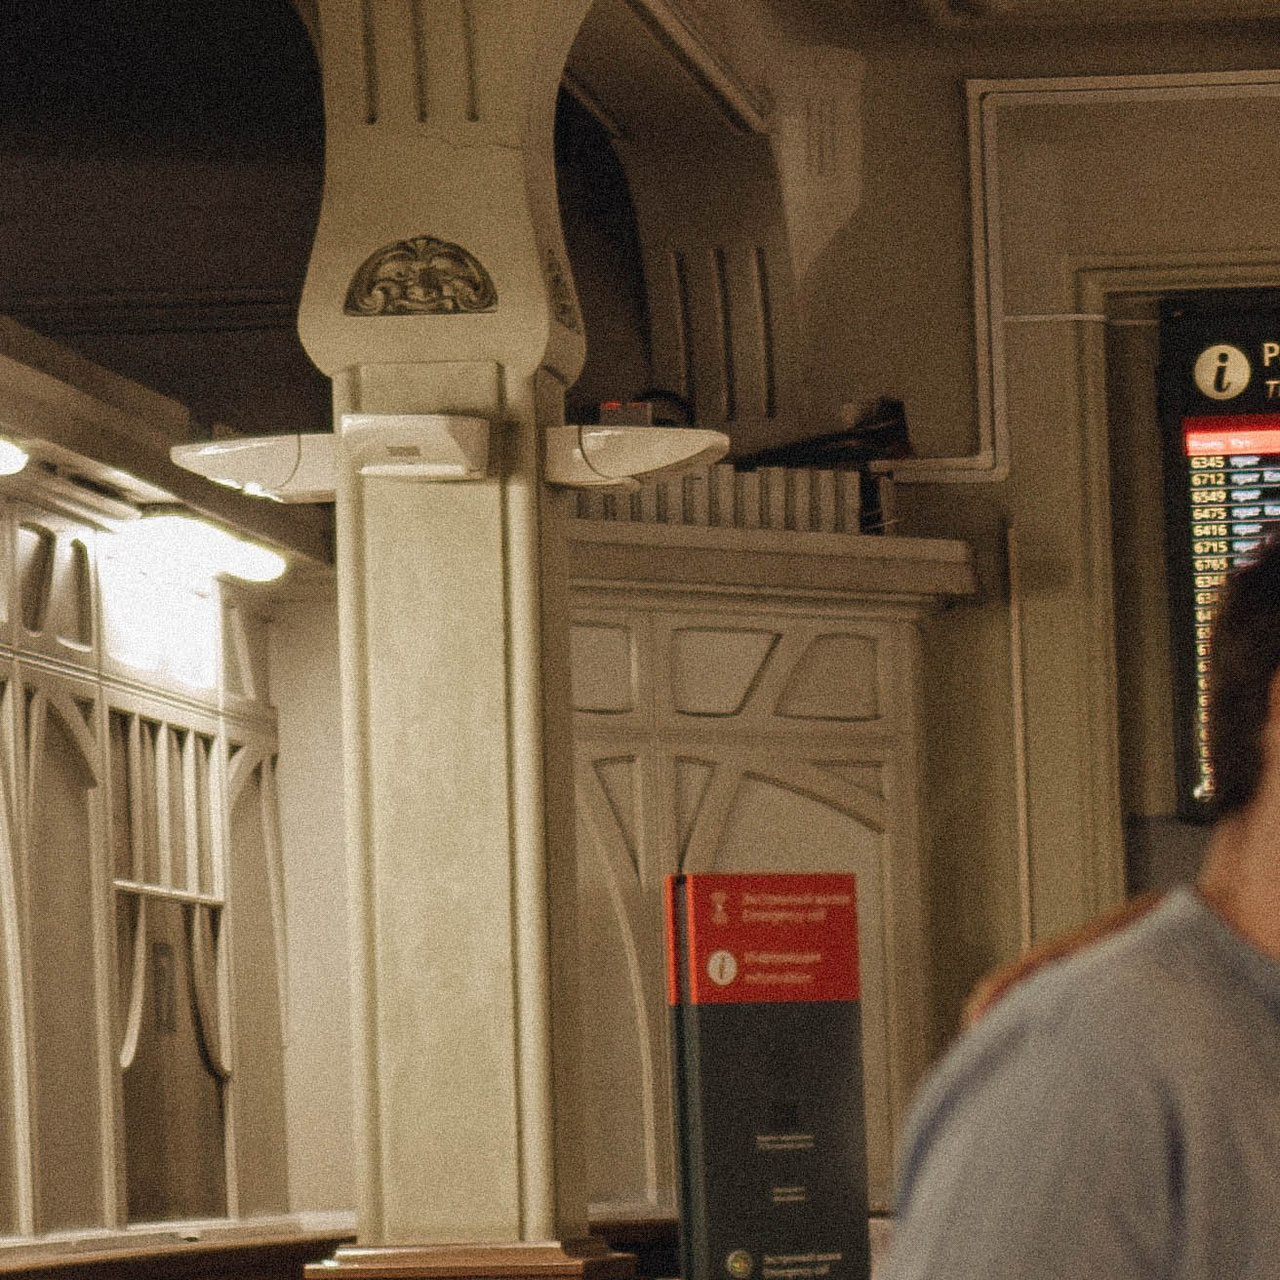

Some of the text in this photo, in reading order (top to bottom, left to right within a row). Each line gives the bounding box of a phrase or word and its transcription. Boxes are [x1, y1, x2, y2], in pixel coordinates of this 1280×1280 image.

[1191, 457, 1224, 468] 6345
[1191, 474, 1224, 485] 6712
[1192, 507, 1227, 519] 6475
[1193, 524, 1227, 536] 6416
[1194, 542, 1228, 553] 6715
